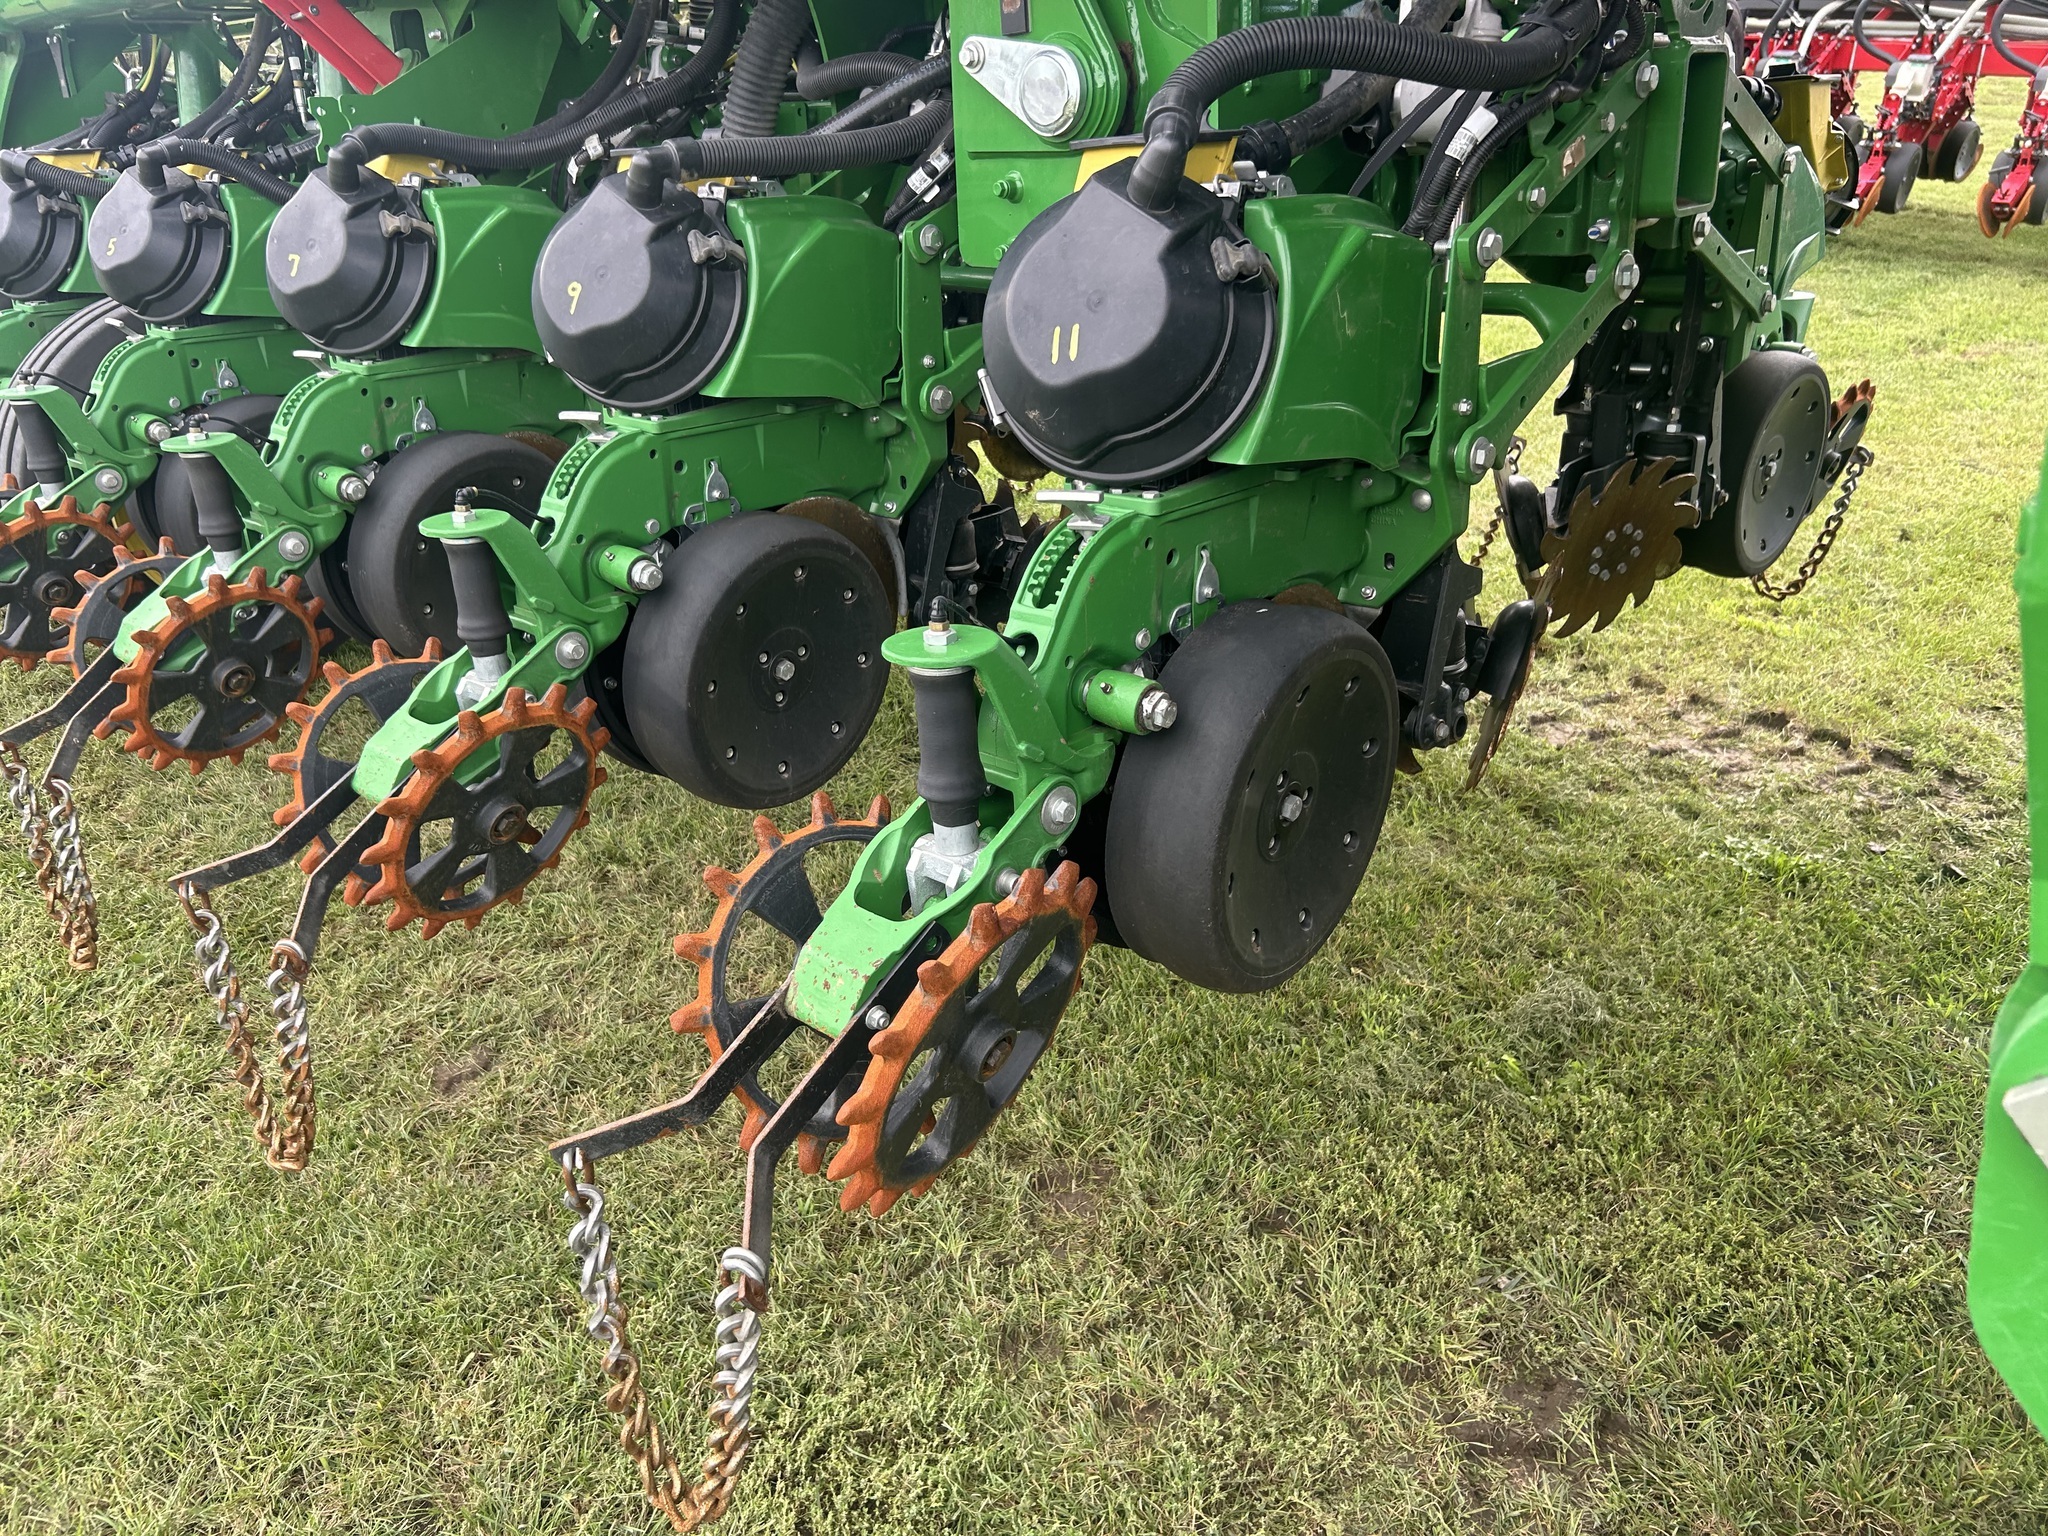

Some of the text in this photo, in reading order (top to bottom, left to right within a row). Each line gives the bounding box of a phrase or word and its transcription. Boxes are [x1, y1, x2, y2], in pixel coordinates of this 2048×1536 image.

[106, 237, 117, 256] 5
[288, 253, 300, 277] 7
[567, 281, 582, 315] 9
[1051, 323, 1080, 365] 11
[1370, 515, 1397, 526] CHINA
[1395, 507, 1405, 517] IN
